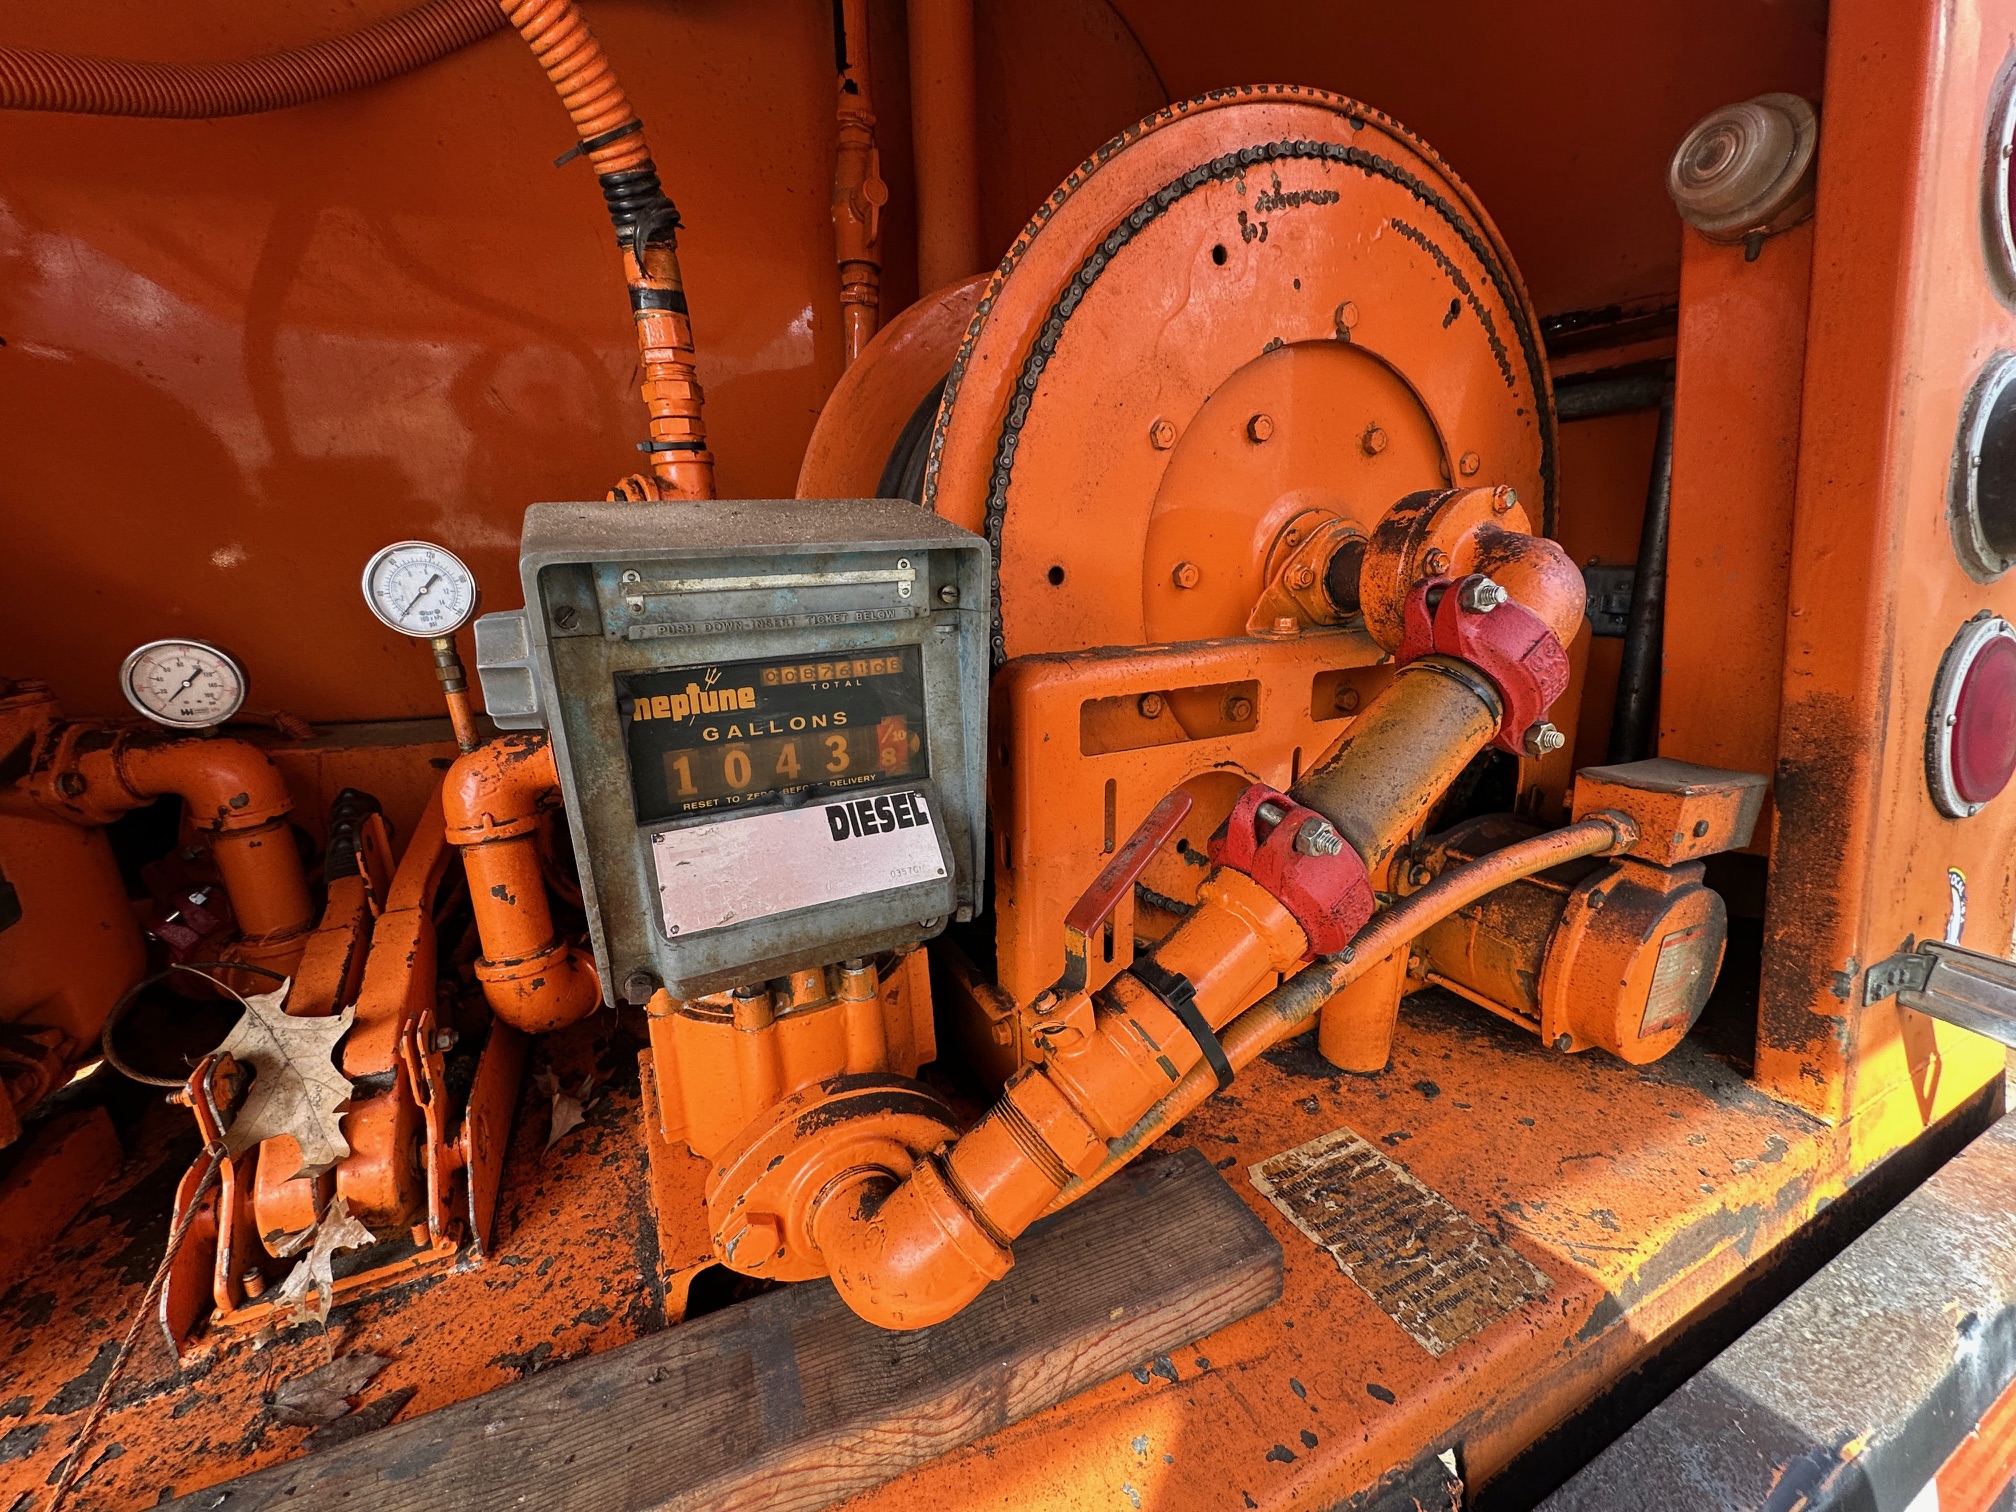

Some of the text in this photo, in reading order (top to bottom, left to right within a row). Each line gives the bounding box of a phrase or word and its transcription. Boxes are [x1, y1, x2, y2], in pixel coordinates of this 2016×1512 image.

[657, 622, 696, 635] PUSH
[807, 612, 848, 625] TICKET
[856, 608, 897, 621] BELOW
[633, 681, 756, 722] neptune
[811, 679, 863, 691] TOTAL
[702, 711, 848, 742] GALLONS
[683, 798, 719, 811] RESET
[726, 795, 740, 803] TO
[830, 773, 877, 788] DELIVERY
[825, 792, 930, 841] DIESEL
